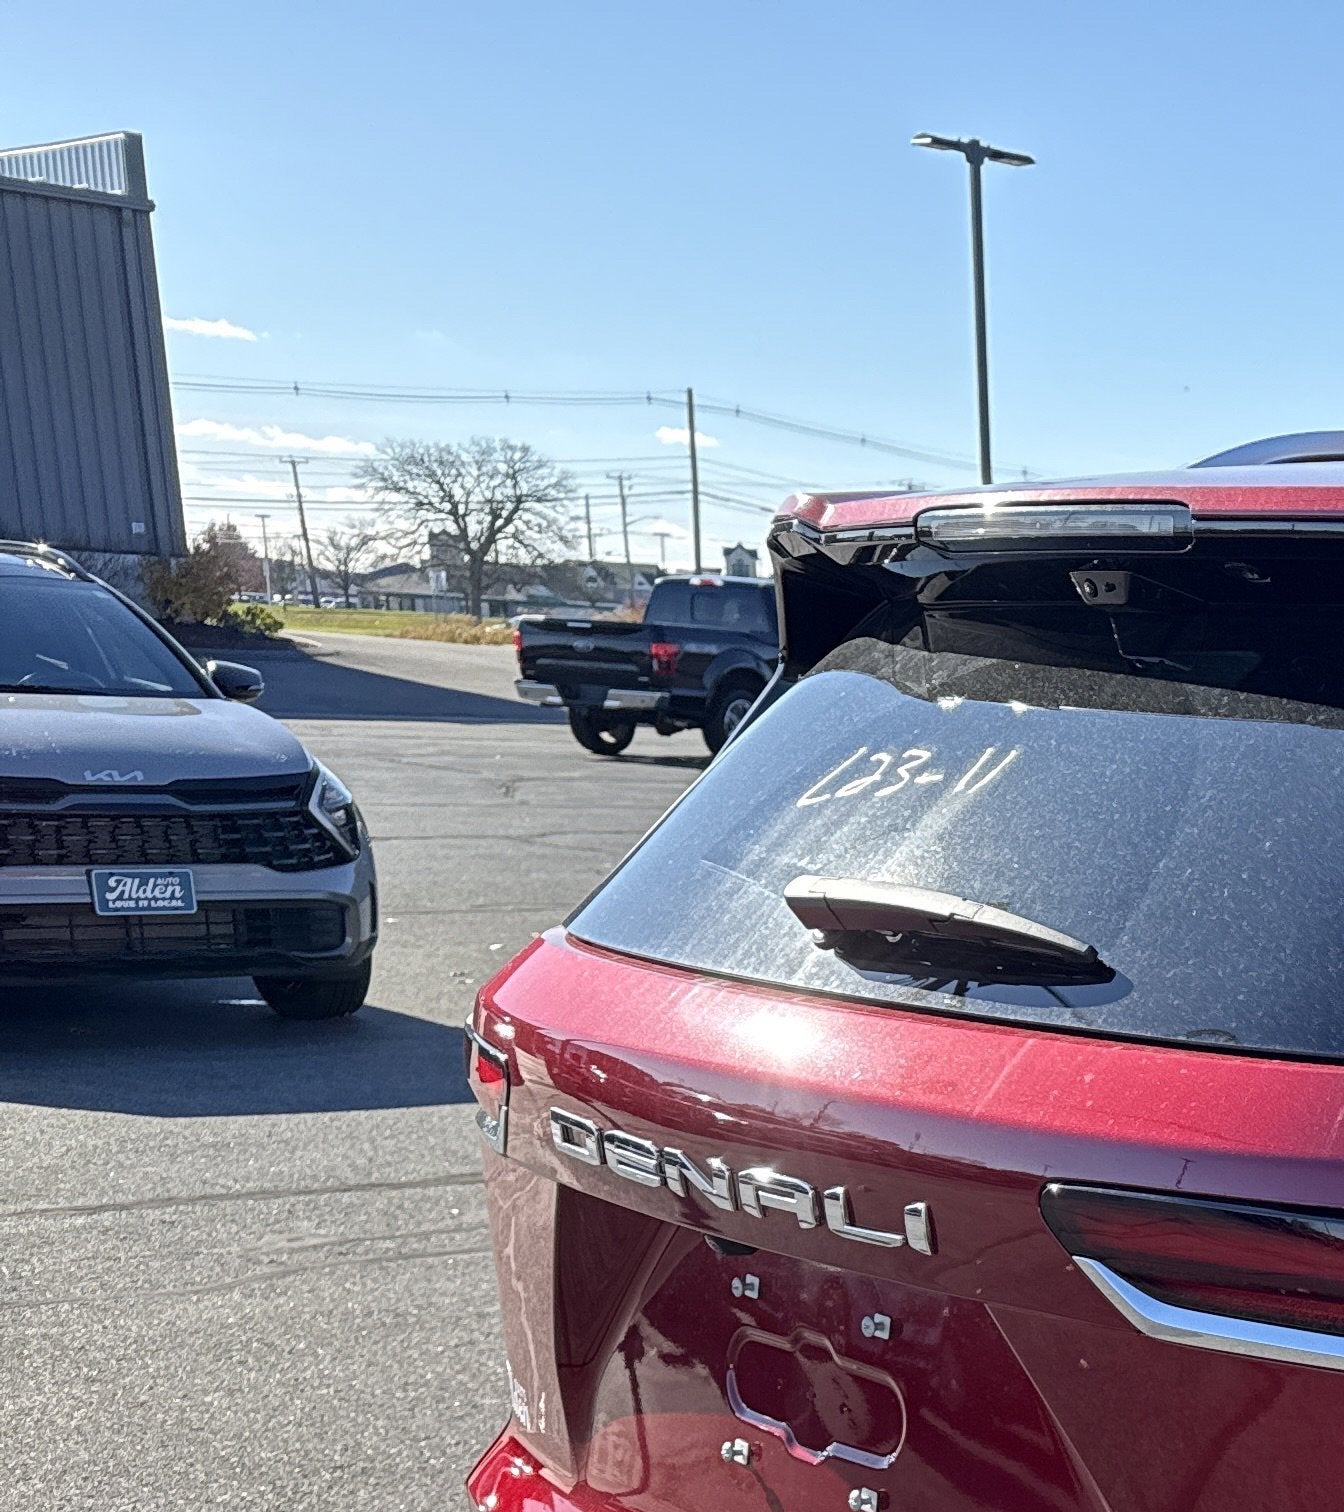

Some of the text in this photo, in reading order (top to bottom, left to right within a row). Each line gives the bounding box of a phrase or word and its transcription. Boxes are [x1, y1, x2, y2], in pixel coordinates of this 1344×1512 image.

[105, 875, 185, 900] Alden
[155, 876, 181, 886] AUTO
[107, 900, 137, 909] LOVE
[150, 899, 186, 908] LOCAL
[549, 1106, 937, 1256] DENALI
